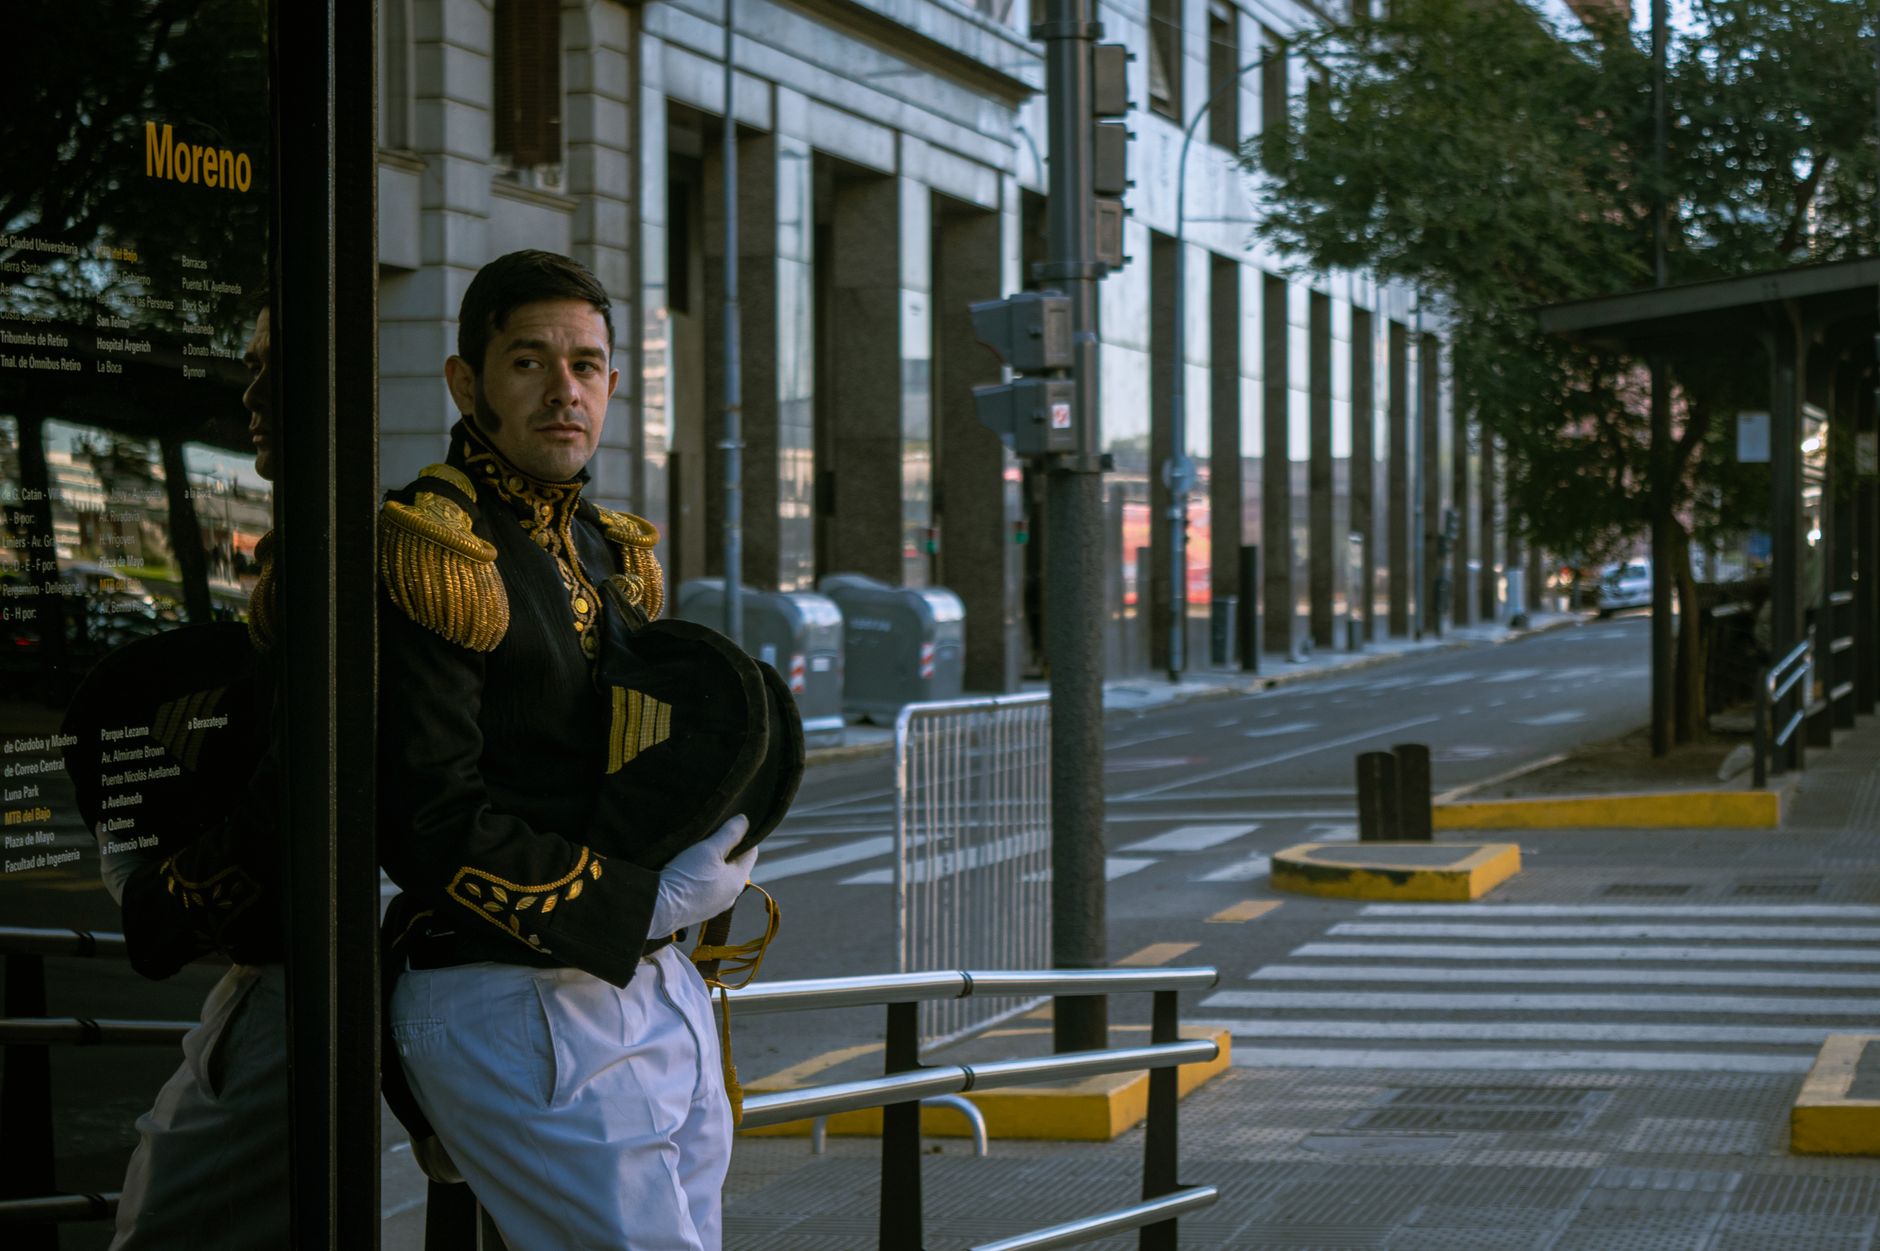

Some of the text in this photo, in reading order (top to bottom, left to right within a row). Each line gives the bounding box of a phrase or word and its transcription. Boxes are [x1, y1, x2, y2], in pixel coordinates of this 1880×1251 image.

[146, 120, 252, 193] Moreno
[10, 235, 34, 250] Ciudad
[35, 237, 79, 254] Universitaria
[112, 248, 122, 259] del
[124, 249, 138, 263] Bajo
[182, 255, 208, 270] Barracas
[122, 271, 151, 286] Gobierno
[182, 277, 242, 294] Puente N. Avellaneda
[137, 297, 146, 307] las
[147, 296, 175, 310] Personas
[198, 300, 210, 313] Sud
[96, 313, 130, 329] San Telmo
[183, 321, 214, 336] Avellaneda
[0, 330, 68, 348] Tribunales de Retiro
[96, 336, 151, 355] Hospital Argerich
[188, 343, 209, 357] Donato
[0, 353, 82, 372] Tnal. de Ómnibus Retiro
[97, 360, 123, 373] La Boca
[21, 488, 43, 501] Catán
[32, 536, 43, 548] Av.
[99, 554, 145, 570] Plaza de Mayo
[2, 583, 40, 599] Pergamino
[99, 577, 115, 592] MTB
[2, 607, 10, 621] G
[192, 713, 228, 729] Berazategui
[101, 726, 149, 742] Parque Lezama
[3, 740, 14, 754] de
[15, 737, 45, 752] Córdoba
[51, 734, 78, 748] Madero
[101, 745, 165, 764] Av. Almirante Brown
[4, 757, 65, 778] de Correo Central
[101, 764, 181, 787] Puente Nicolás Avellaneda
[4, 784, 40, 801] Luna Park
[107, 792, 143, 808] Avellaneda
[4, 806, 52, 826] MTB del Bajo
[107, 817, 135, 831] Quilmes
[4, 830, 55, 849] Plaza de Mayo
[107, 838, 138, 855] Florencio
[138, 834, 159, 849] Varela
[4, 848, 81, 873] Facultad de Ingeniería
